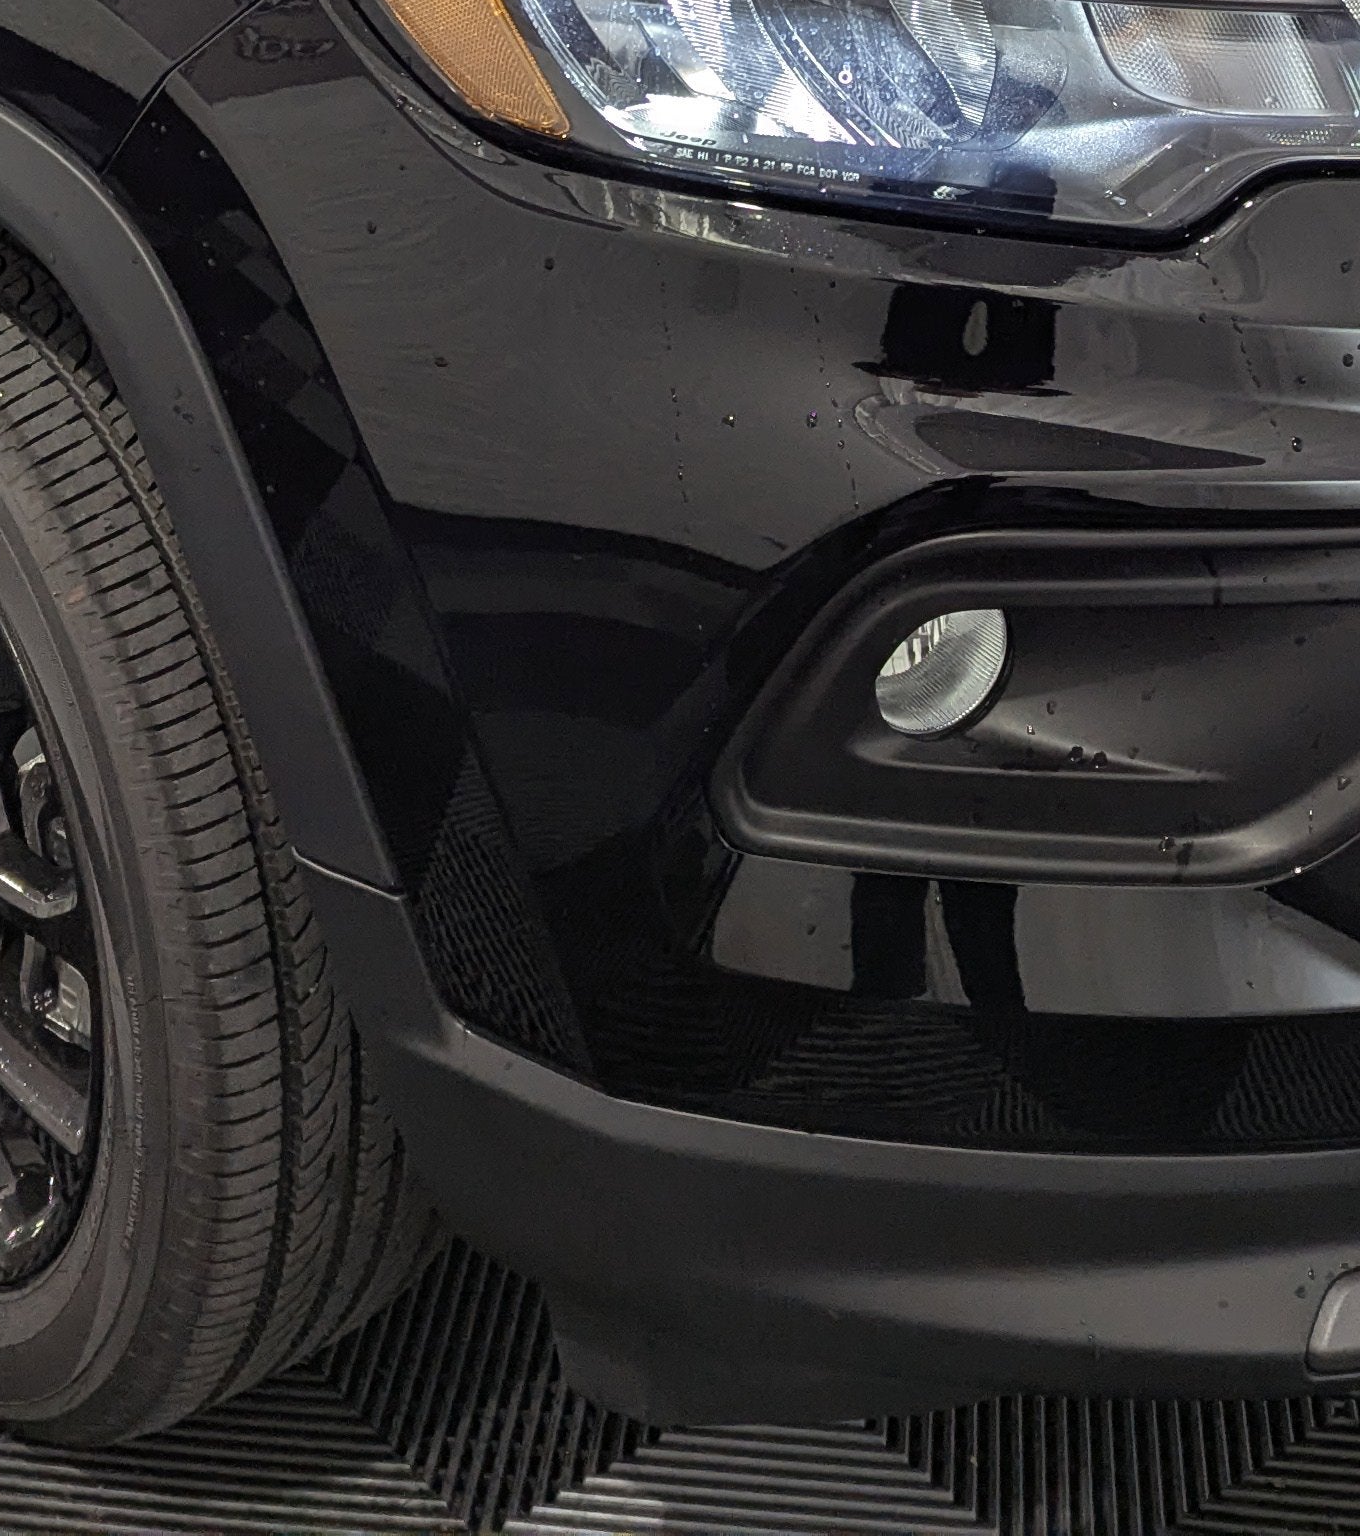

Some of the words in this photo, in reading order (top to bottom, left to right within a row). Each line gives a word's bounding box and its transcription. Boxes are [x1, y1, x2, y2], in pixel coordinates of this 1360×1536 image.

[660, 131, 717, 146] Jeep
[674, 148, 694, 160] SAE
[724, 154, 732, 164] P
[796, 164, 816, 177] FCA
[819, 168, 839, 180] DOT
